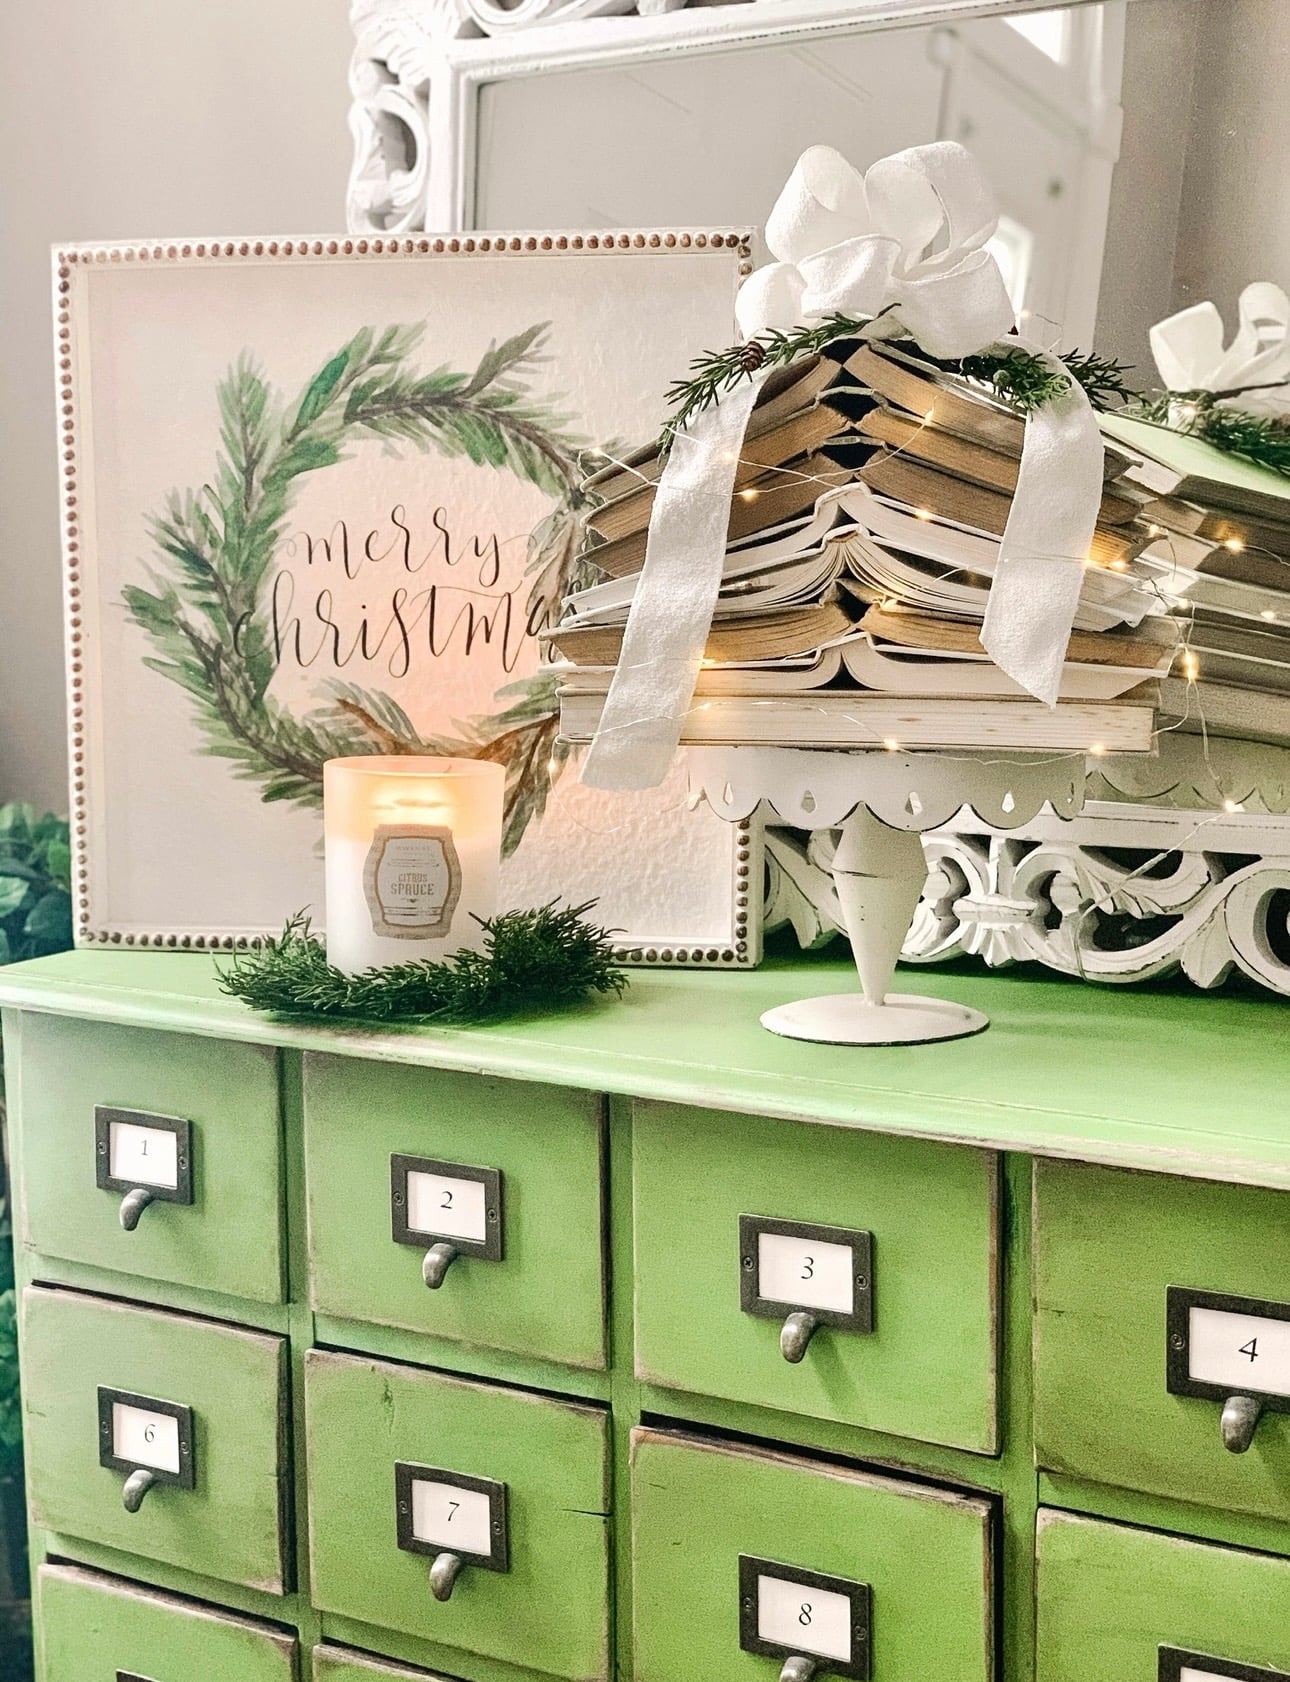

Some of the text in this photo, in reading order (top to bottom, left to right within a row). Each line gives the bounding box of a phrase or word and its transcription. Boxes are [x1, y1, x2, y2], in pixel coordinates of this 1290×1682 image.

[271, 504, 536, 587] merry
[398, 872, 428, 882] CITRUS
[390, 883, 434, 895] SPRUCE
[140, 1139, 148, 1156] 1
[439, 1190, 453, 1210] 2
[800, 1256, 815, 1280] 3
[1237, 1336, 1259, 1362] 4
[144, 1423, 156, 1443] 6
[447, 1501, 461, 1522] 7
[798, 1602, 813, 1626] 8
